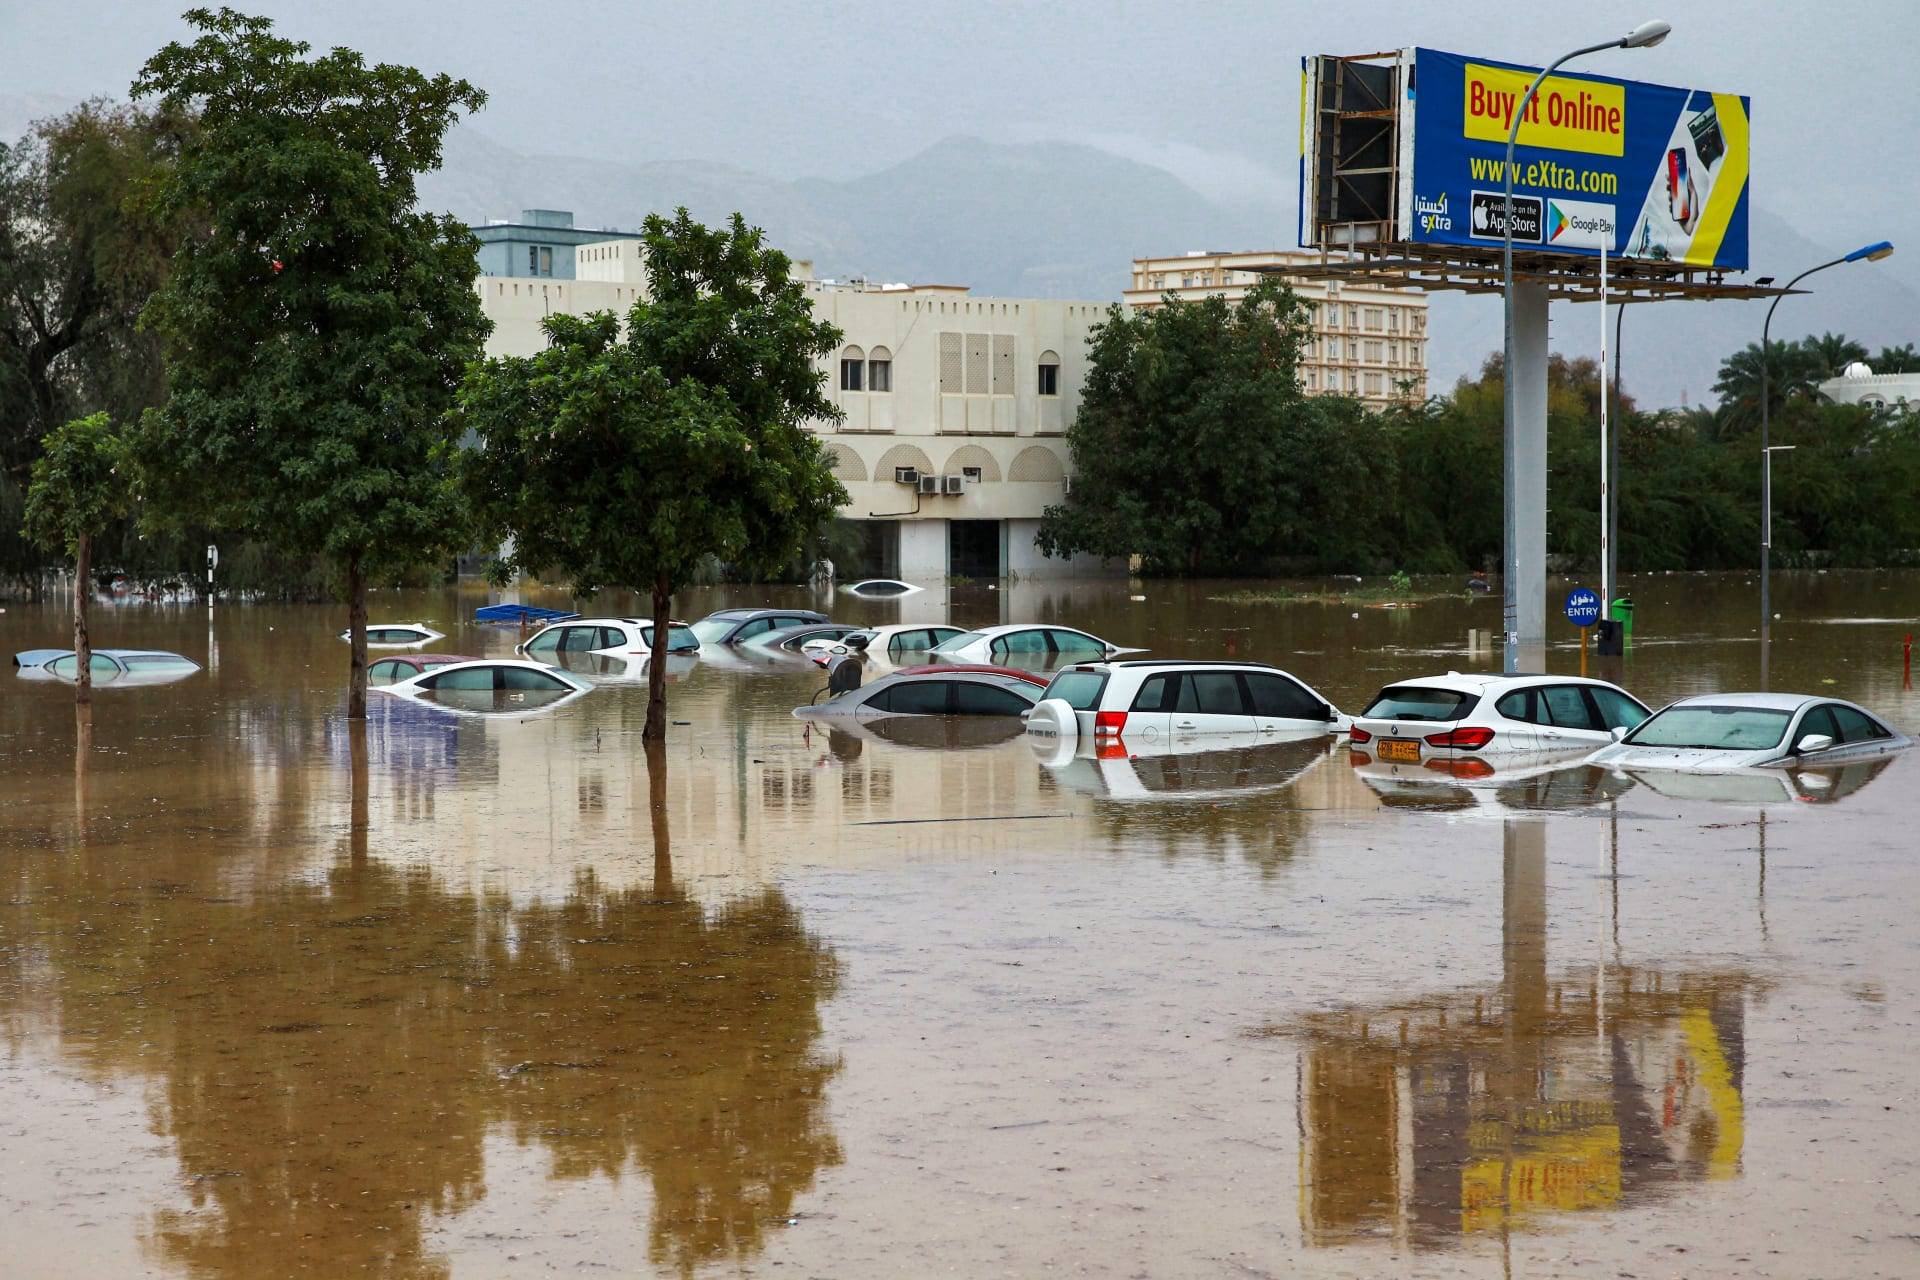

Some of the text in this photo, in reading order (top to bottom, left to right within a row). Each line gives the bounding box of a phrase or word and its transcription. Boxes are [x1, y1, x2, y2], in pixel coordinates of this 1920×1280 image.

[1470, 80, 1621, 134] Buy it Online
[1470, 157, 1617, 195] www.eXtra.com
[1489, 202, 1517, 213] Availle
[1527, 206, 1537, 215] the
[1511, 215, 1537, 233] Store
[1571, 216, 1615, 236] Google Play
[1571, 593, 1594, 606] دخول
[1567, 607, 1599, 617] ENTRY
